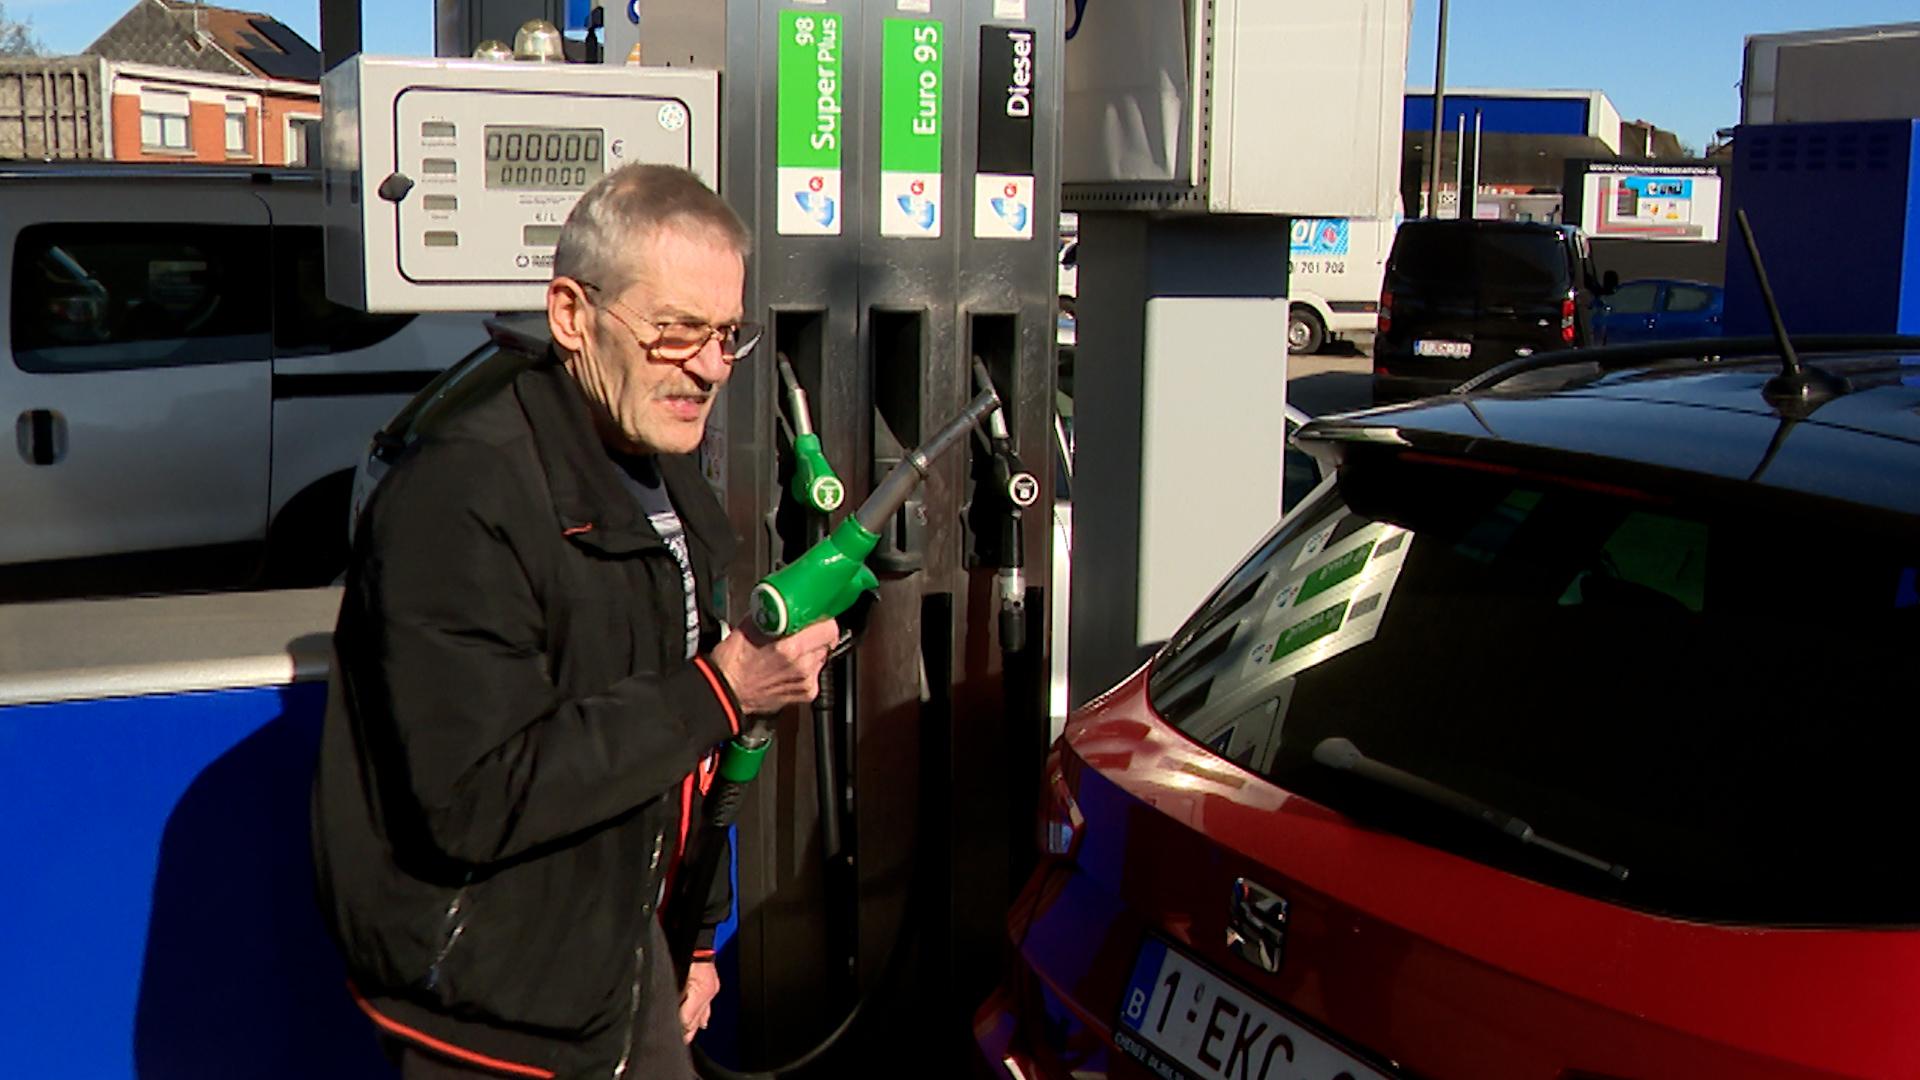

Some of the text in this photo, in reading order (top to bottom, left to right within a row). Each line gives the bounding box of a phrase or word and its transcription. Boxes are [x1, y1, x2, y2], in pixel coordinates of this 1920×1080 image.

[794, 16, 815, 46] 98
[810, 17, 842, 151] Super Plus
[912, 26, 938, 135] Euro 95
[1006, 30, 1033, 117] Diesel
[1301, 261, 1319, 274] 701
[1325, 261, 1345, 274] 702
[1127, 988, 1146, 1020] B
